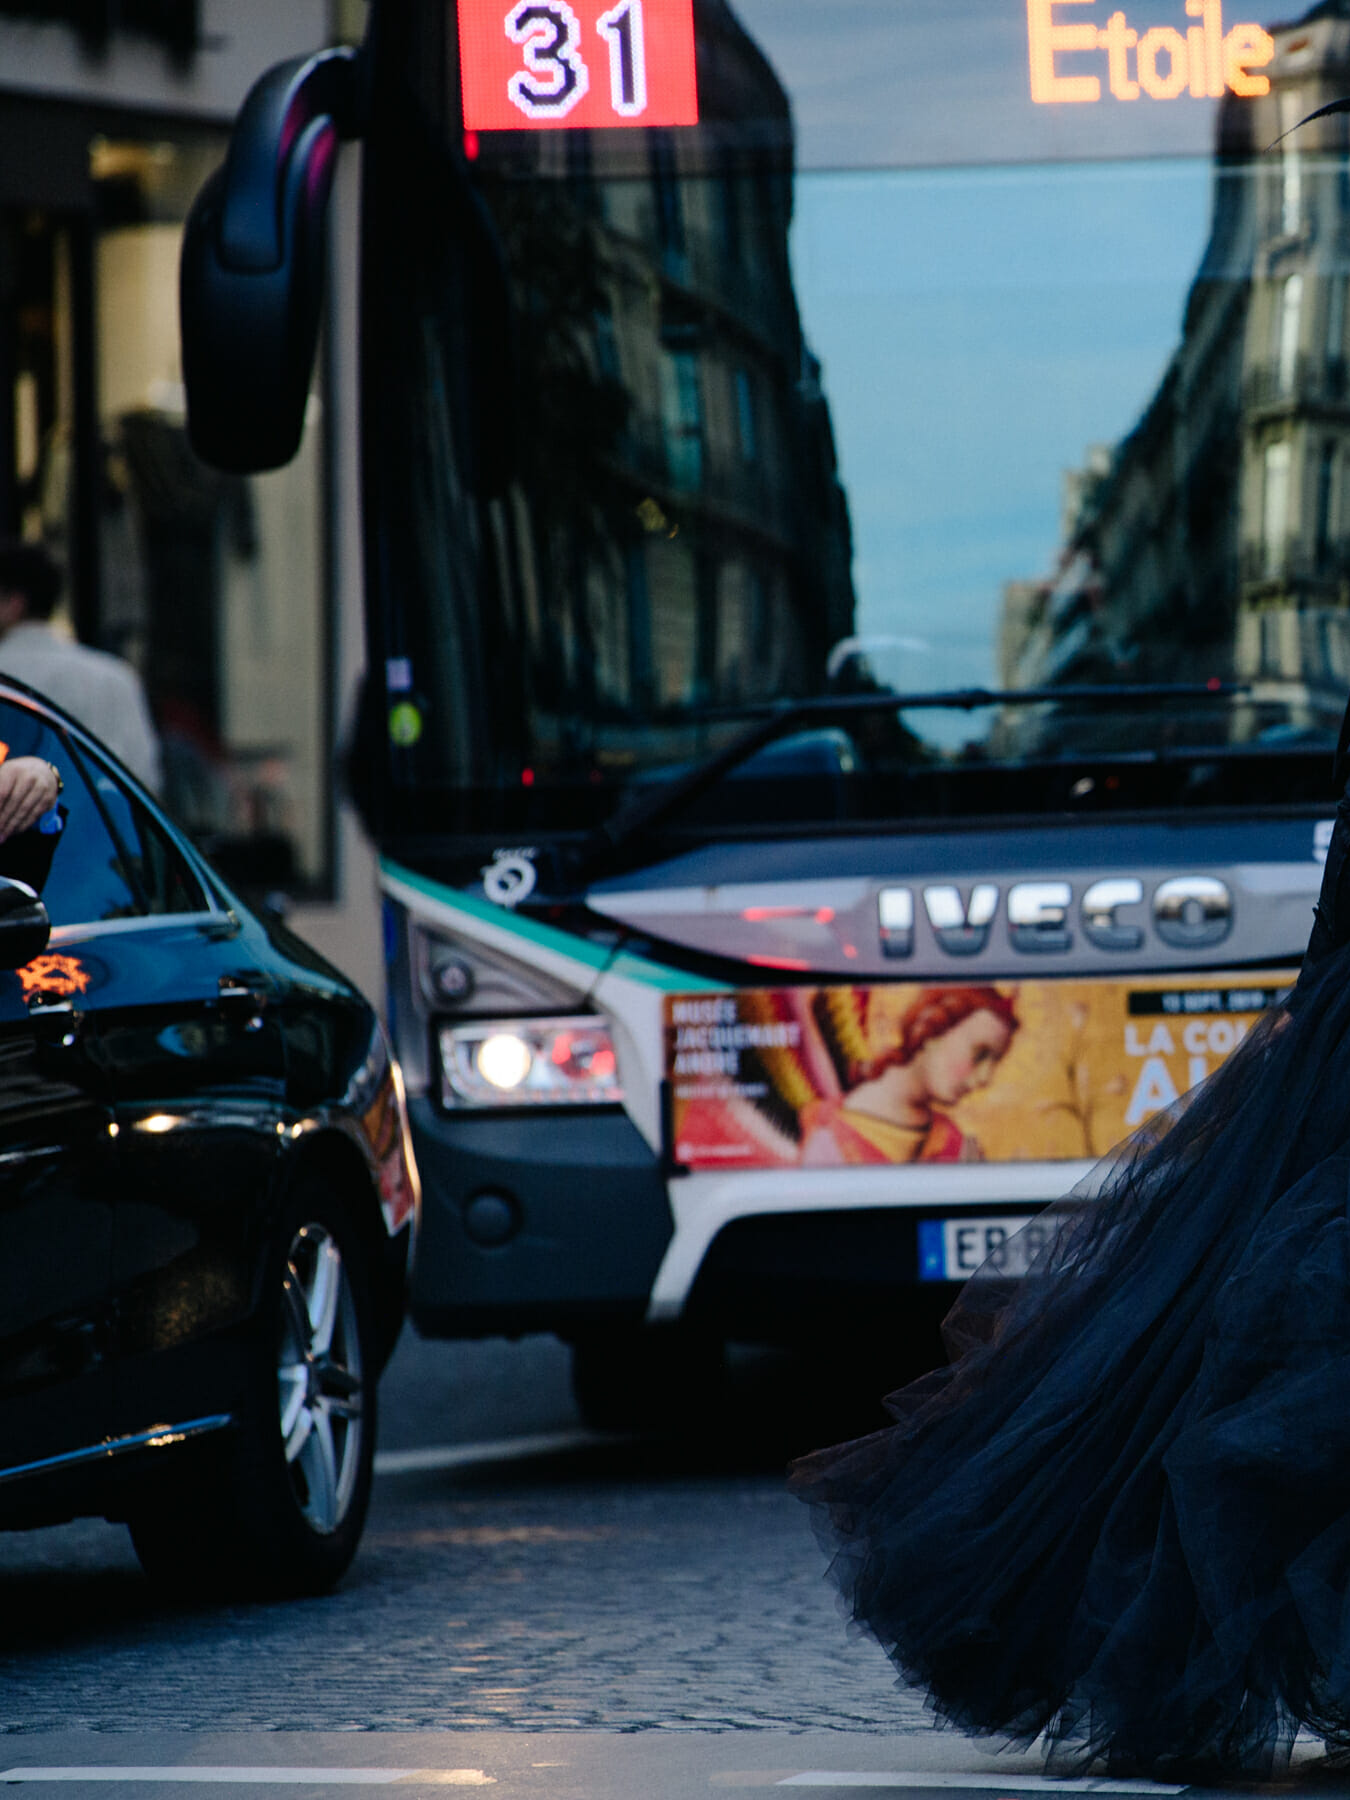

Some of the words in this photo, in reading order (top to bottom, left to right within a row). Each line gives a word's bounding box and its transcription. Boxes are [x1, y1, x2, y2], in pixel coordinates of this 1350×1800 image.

[504, 0, 647, 118] 31
[878, 876, 1235, 960] IVECO
[1124, 1022, 1175, 1056] LA
